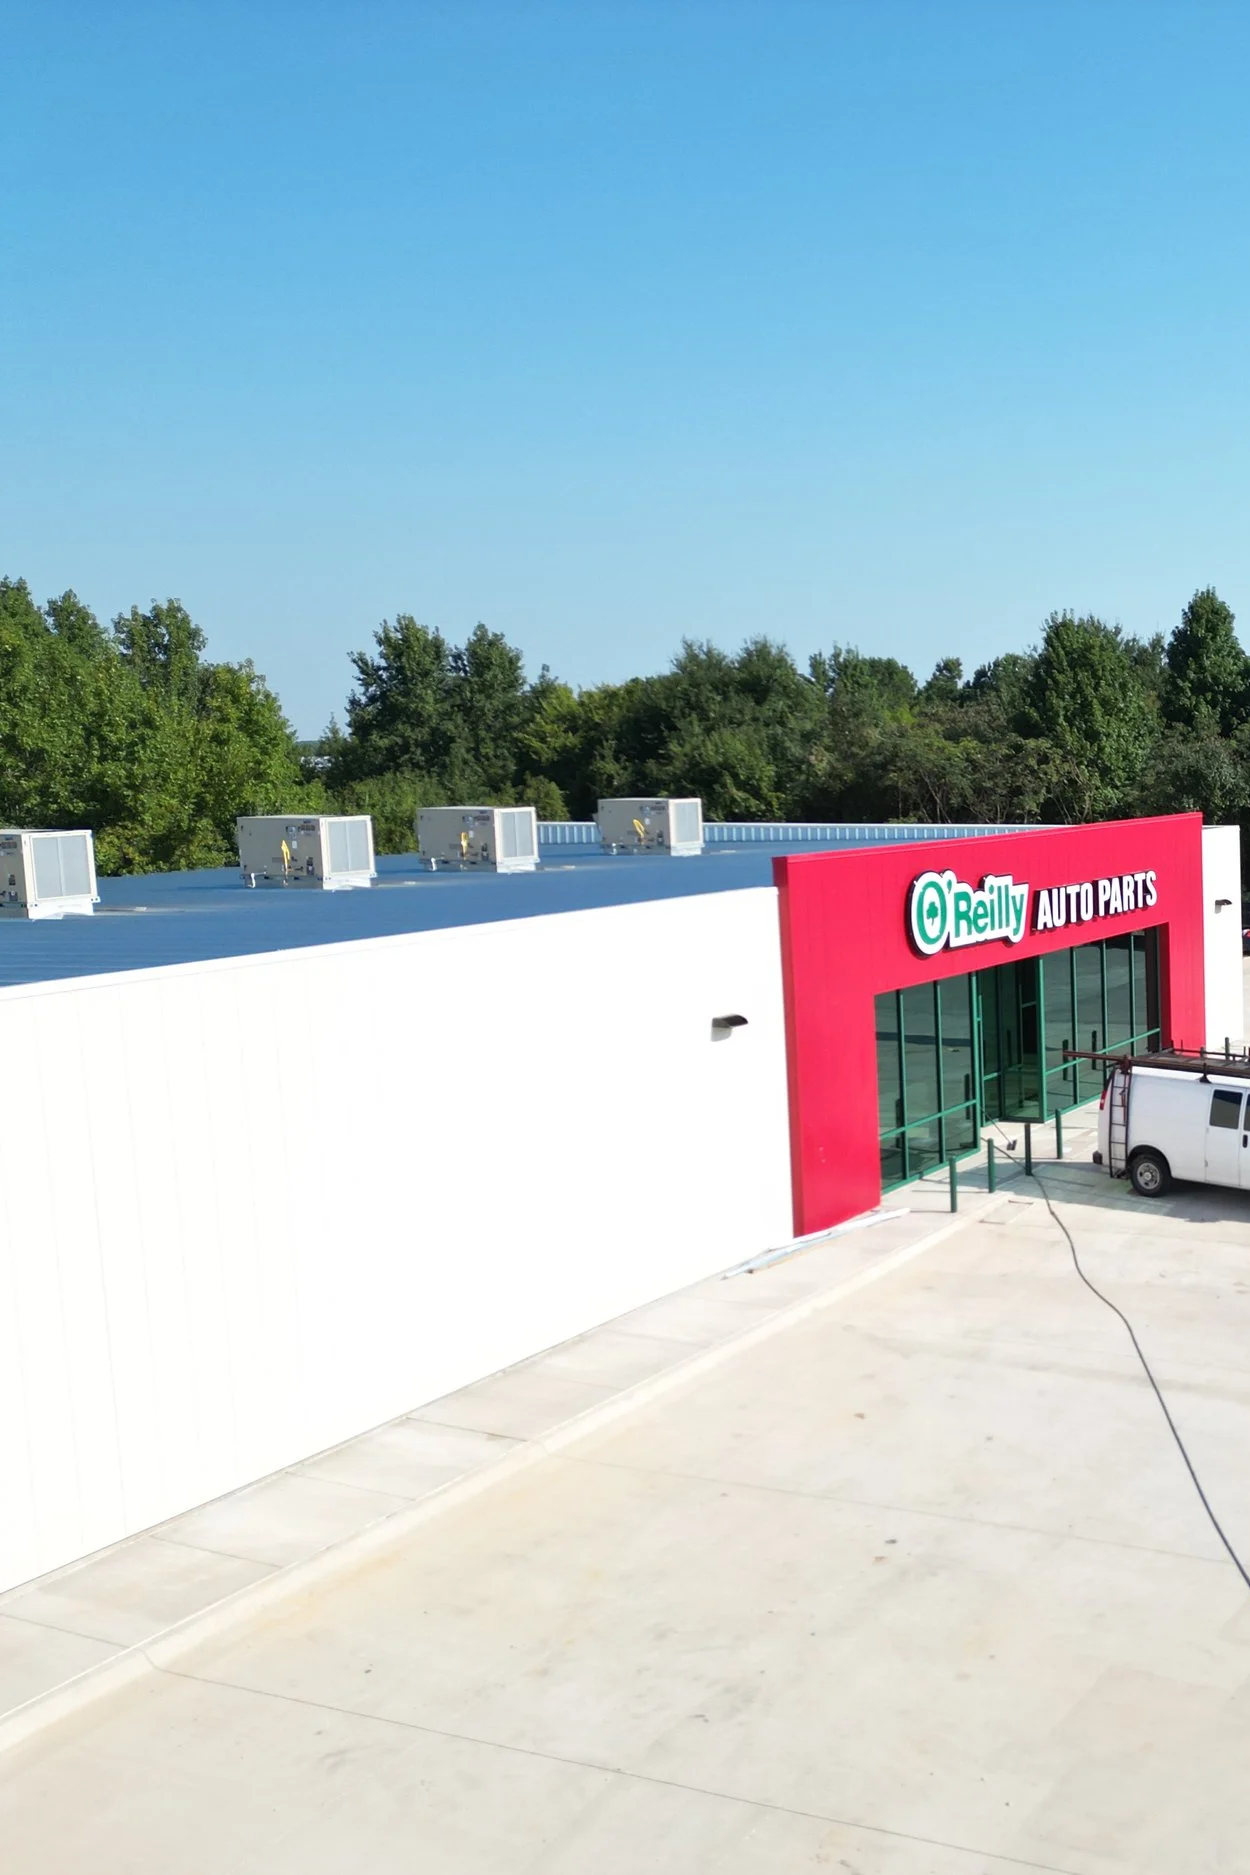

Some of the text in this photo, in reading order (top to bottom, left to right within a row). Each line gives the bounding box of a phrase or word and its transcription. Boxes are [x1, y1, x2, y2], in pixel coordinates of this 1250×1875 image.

[915, 870, 1158, 946] O'Reilly AUTO PARTS
